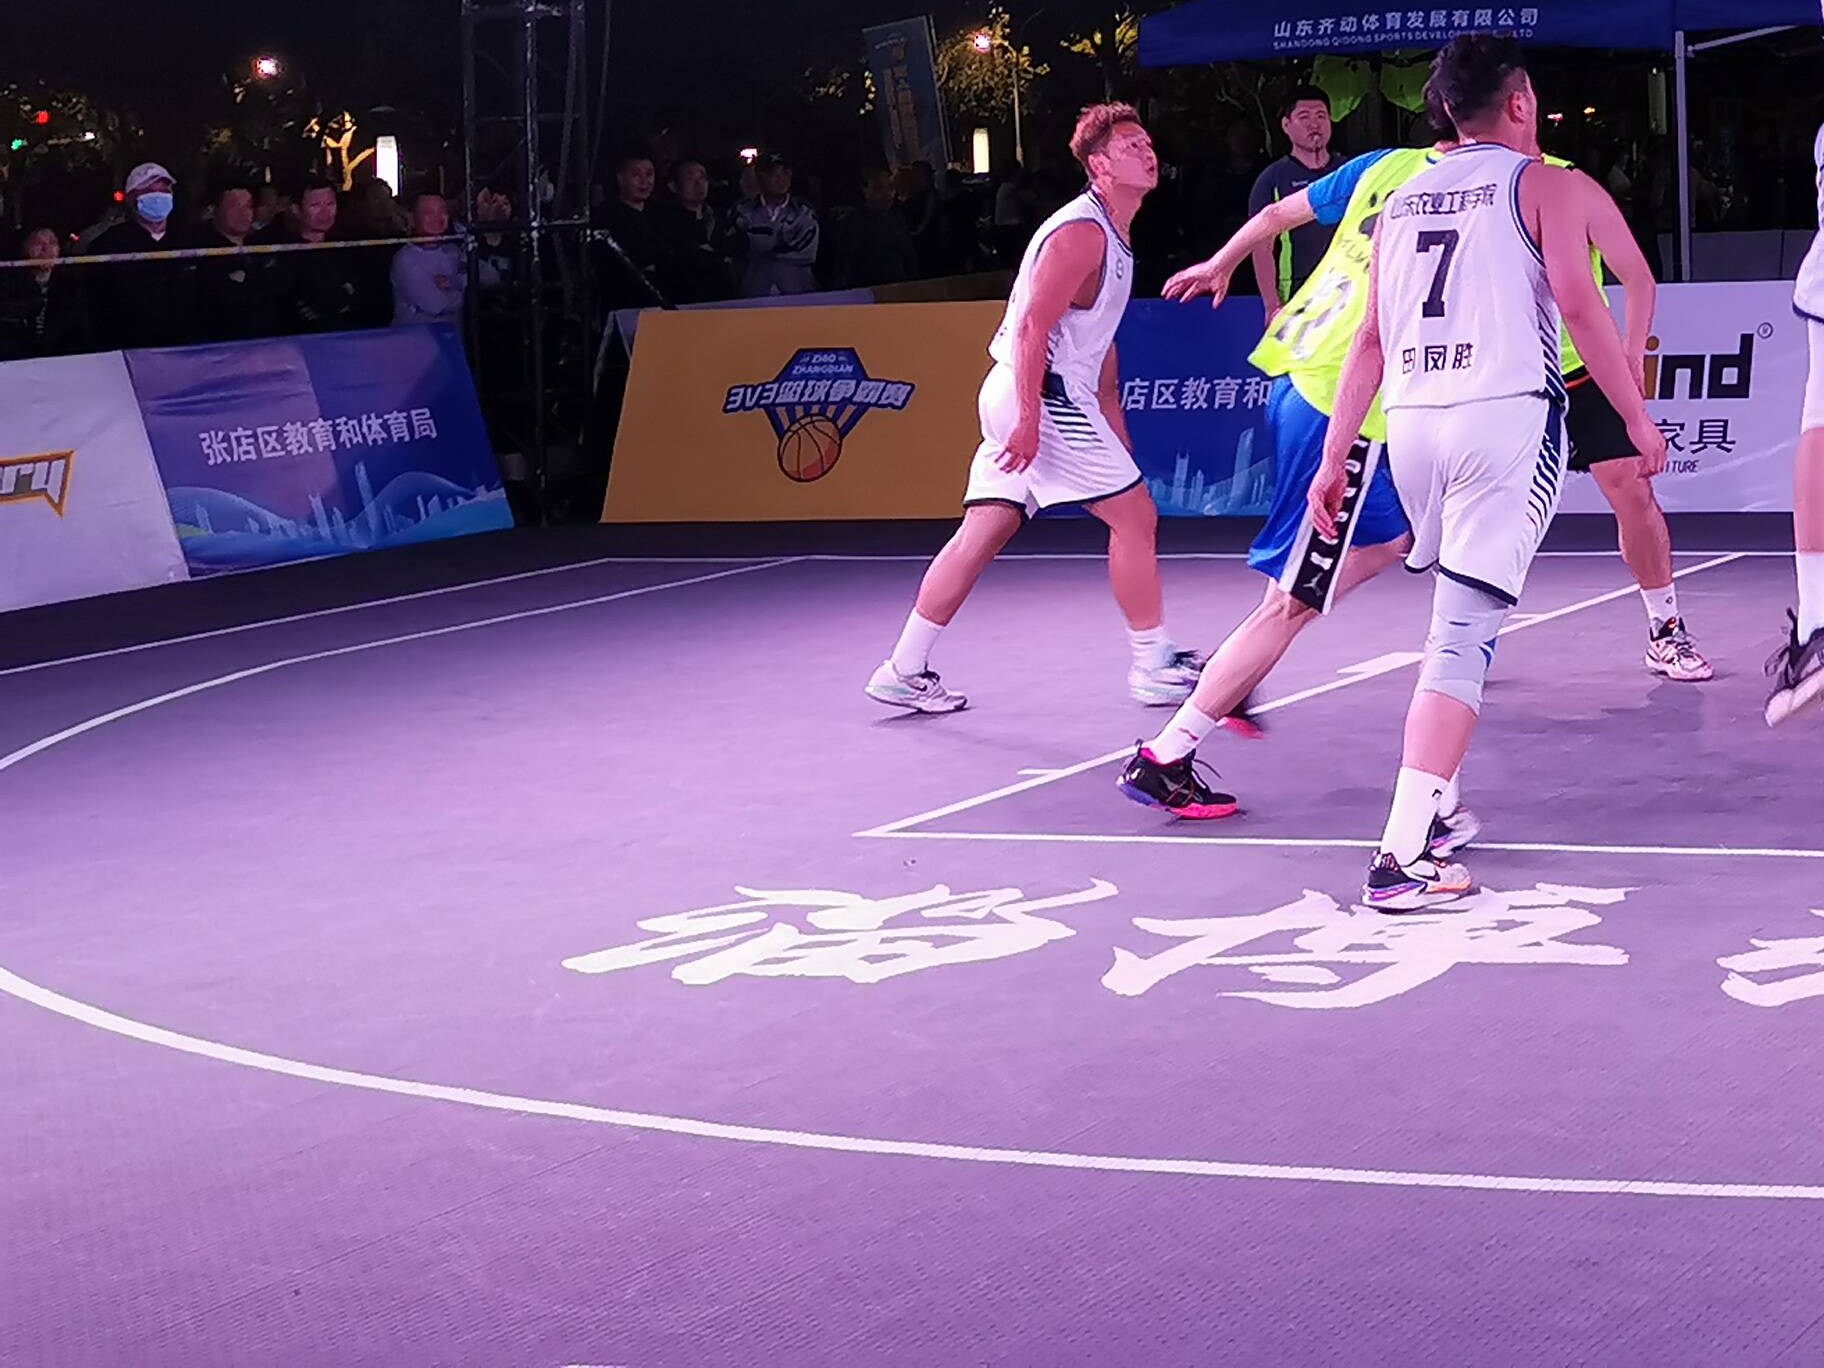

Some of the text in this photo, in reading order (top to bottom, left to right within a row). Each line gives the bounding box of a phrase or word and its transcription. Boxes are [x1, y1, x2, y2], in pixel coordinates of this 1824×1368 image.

[1273, 7, 1539, 38] 山东齐动体育发展有限公司
[1273, 38, 1331, 50] SHANDONG
[1374, 32, 1415, 43] SPORTS
[1416, 229, 1460, 318] 7
[199, 407, 438, 466] 张店区教育和体育局
[1654, 418, 1737, 455] 家具
